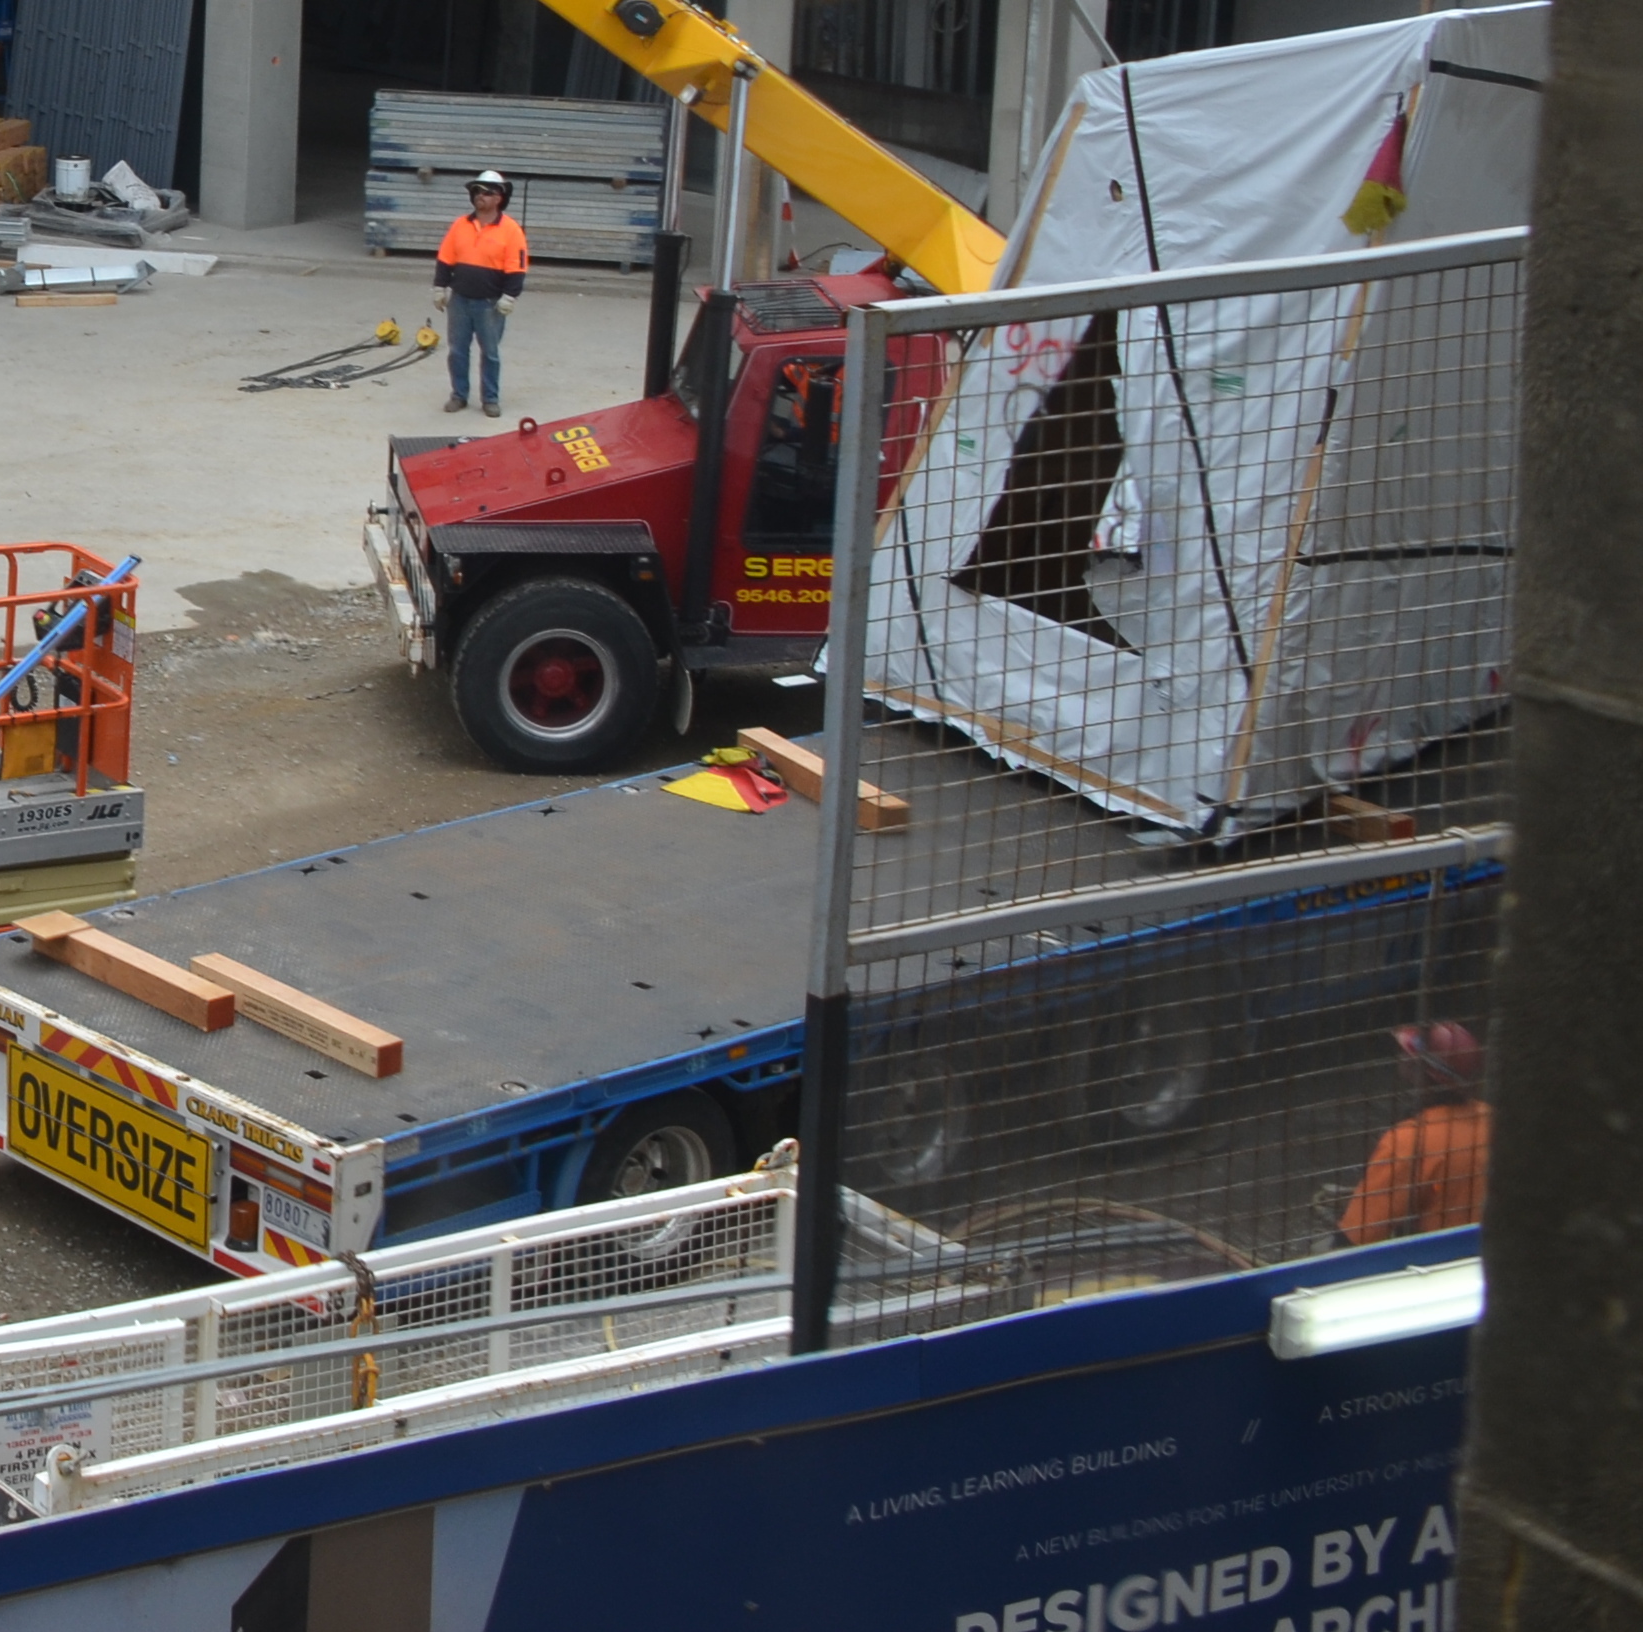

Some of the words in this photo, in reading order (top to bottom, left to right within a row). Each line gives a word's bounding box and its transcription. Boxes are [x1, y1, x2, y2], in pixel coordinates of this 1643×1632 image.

[553, 425, 612, 474] SERGI
[17, 804, 73, 824] 1930ES
[86, 802, 124, 821] JLG
[18, 1071, 196, 1223] OVERSIZE
[186, 1096, 239, 1135] CRANE
[242, 1120, 304, 1163] TRUCKS
[1339, 1386, 1426, 1419] STRONG
[0, 1459, 38, 1474] FIRST
[6, 1438, 36, 1449] 1300
[16, 1451, 23, 1459] 4
[27, 1441, 81, 1458] PERN
[951, 1457, 1065, 1501] LEARNING
[1071, 1436, 1177, 1476] BUILDING
[1035, 1531, 1082, 1558] NEW
[1086, 1512, 1184, 1547] BUILDING
[1187, 1503, 1227, 1528] FOR
[1232, 1493, 1266, 1517] THE
[1271, 1467, 1379, 1508] UNIVERSITY
[1383, 1457, 1411, 1482] OF
[1310, 1516, 1399, 1589] BY
[1273, 1578, 1458, 1632] CHI
